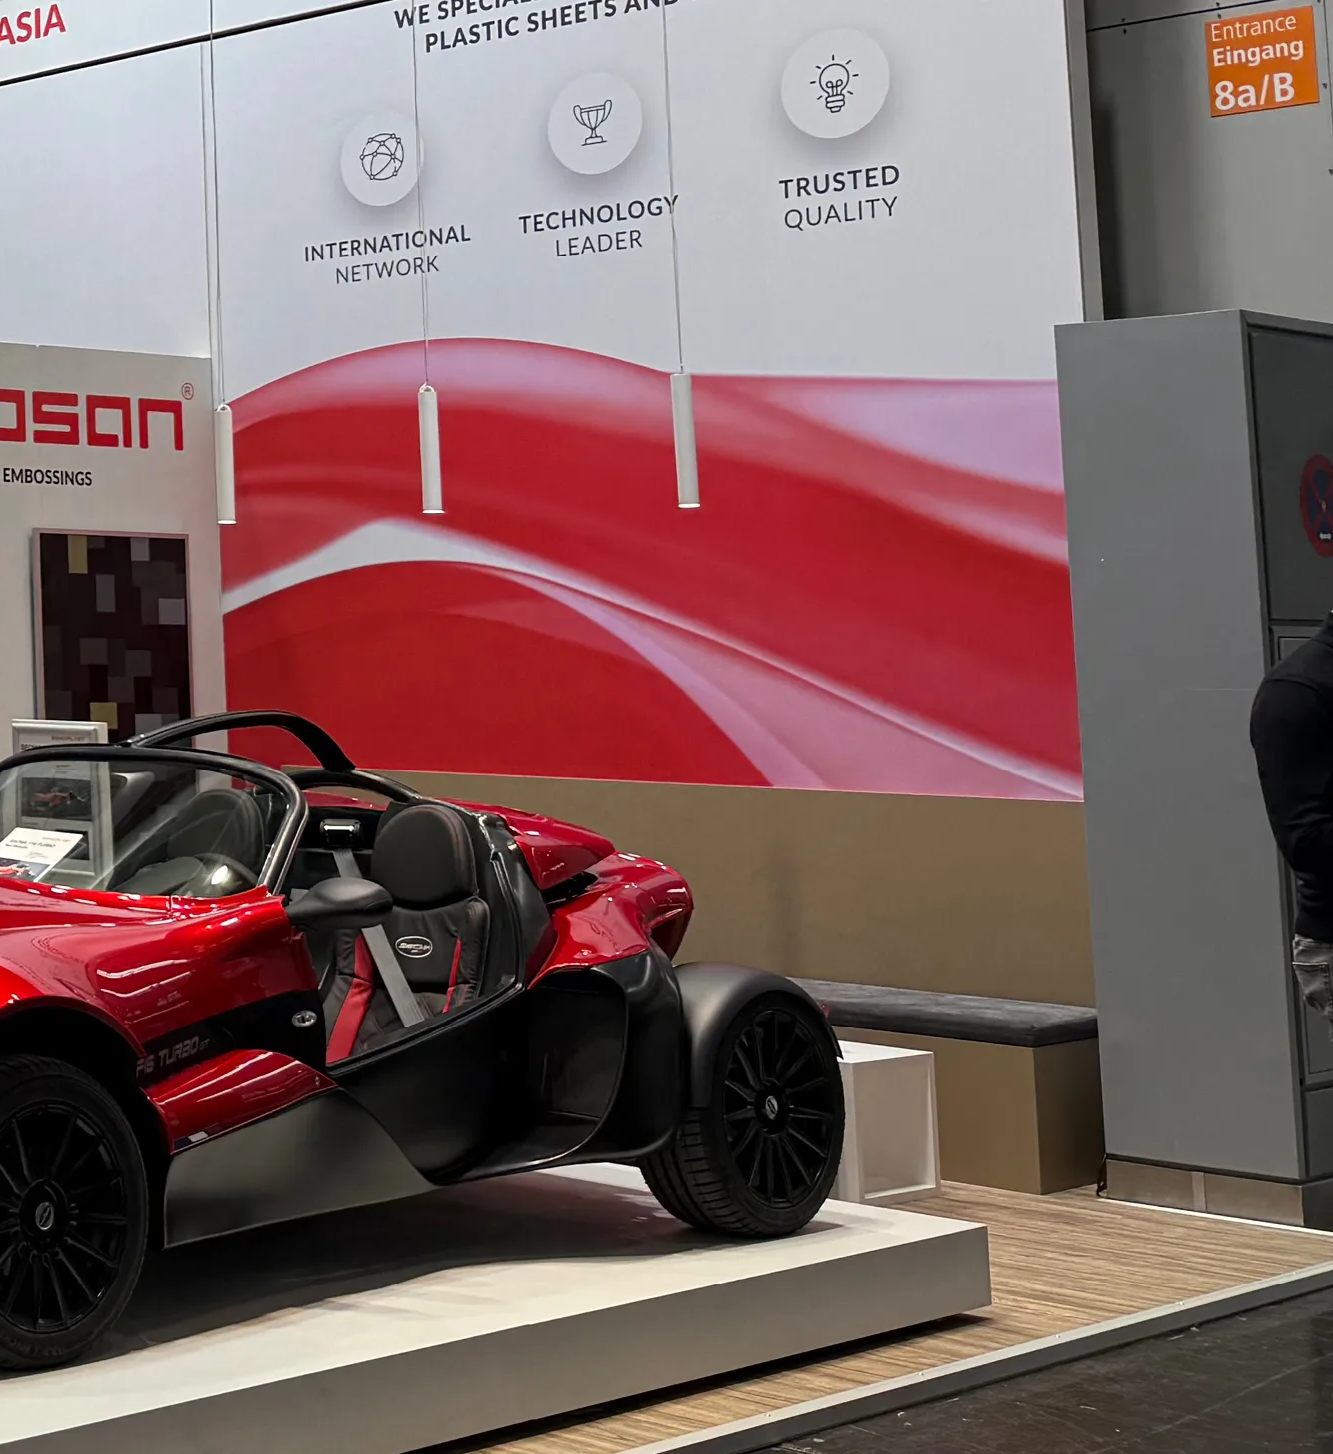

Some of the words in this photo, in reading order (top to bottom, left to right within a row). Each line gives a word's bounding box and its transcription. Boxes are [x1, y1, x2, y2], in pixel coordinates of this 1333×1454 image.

[394, 4, 430, 29] WE
[425, 16, 520, 53] PLASTIC
[527, 1, 617, 33] SHEETS
[1211, 15, 1297, 41] Entrance
[1213, 40, 1304, 67] Eingang
[1215, 72, 1295, 111] 8a/B
[779, 164, 901, 200] TRUSTED
[518, 194, 679, 235] TECHNOLOGY
[783, 196, 899, 231] QUALITY
[304, 224, 471, 262] INTERNATIONAL
[555, 229, 644, 258] LEADER
[336, 255, 440, 284] NETWORK
[3, 466, 93, 487] EMBOSSINGS
[159, 1035, 200, 1069] TURBO
